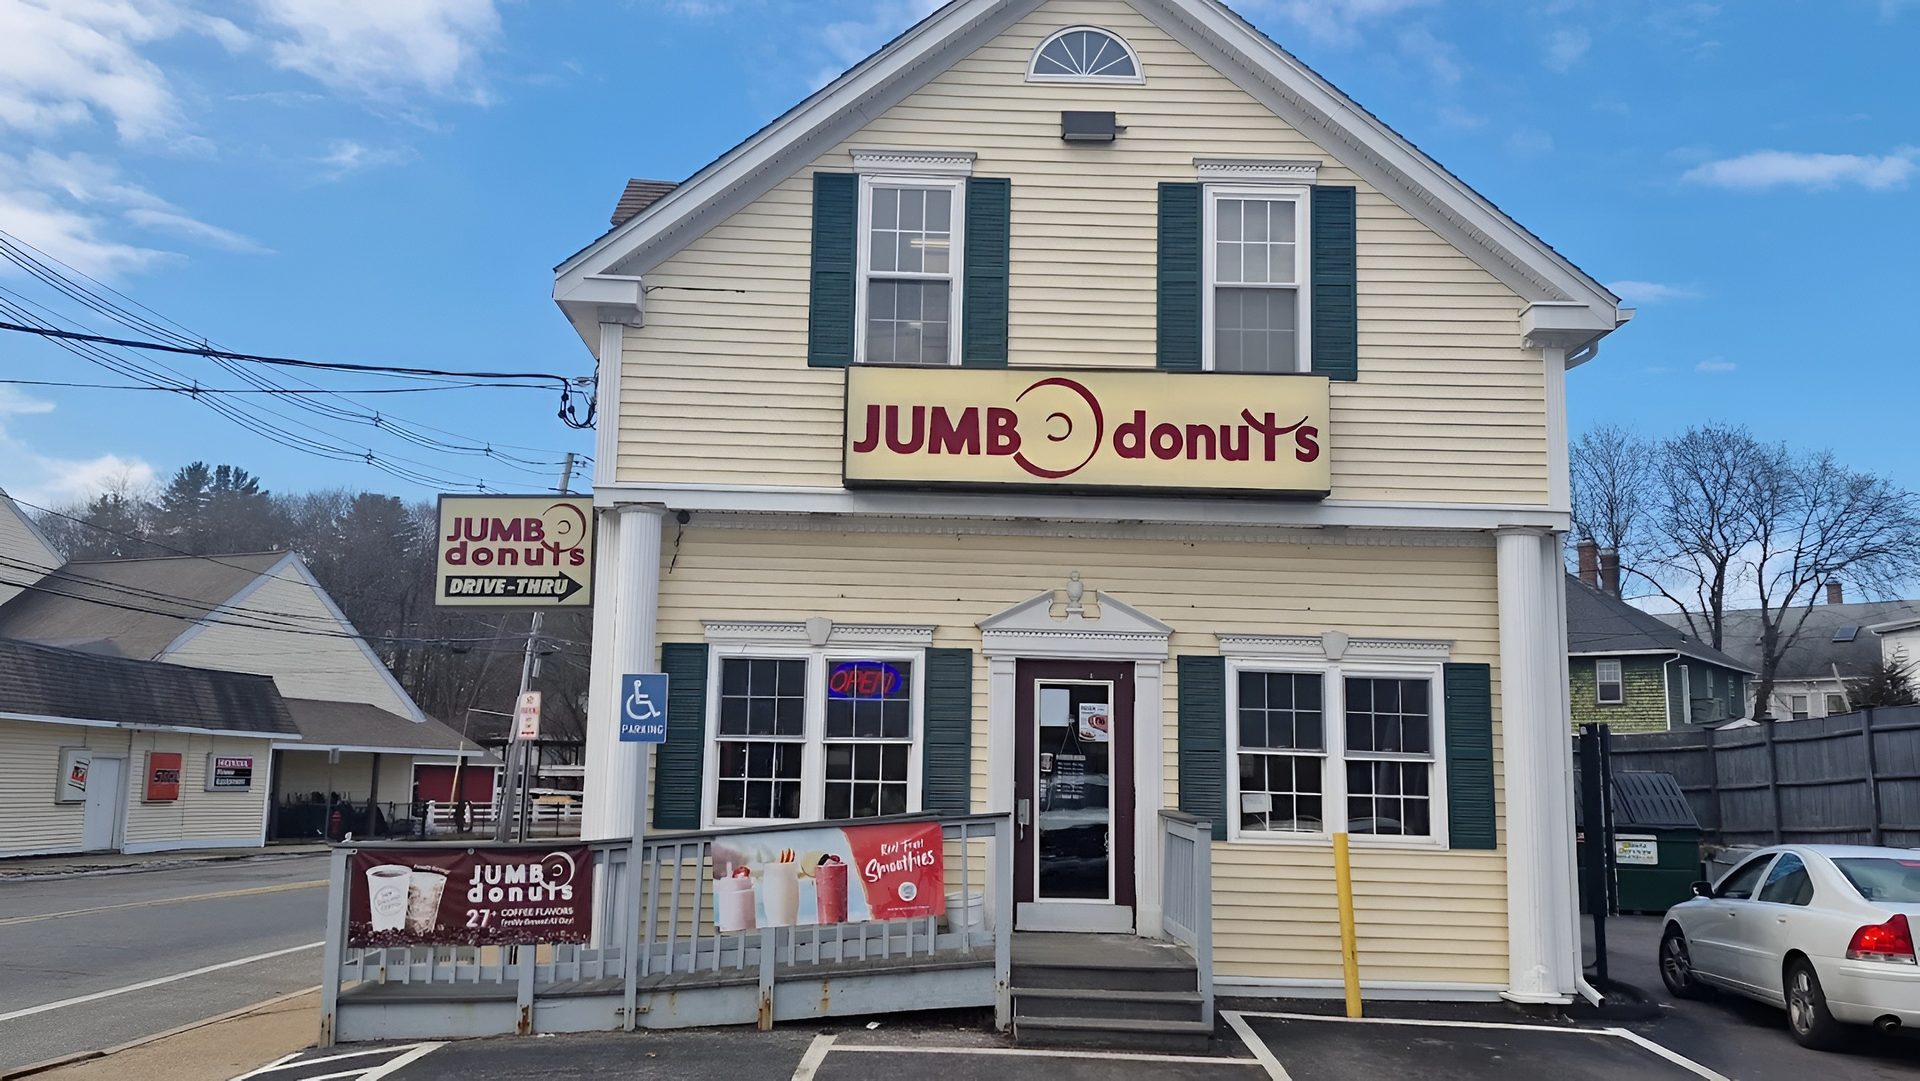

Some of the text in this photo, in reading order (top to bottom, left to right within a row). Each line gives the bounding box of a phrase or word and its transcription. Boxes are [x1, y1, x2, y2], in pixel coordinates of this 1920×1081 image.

[1113, 407, 1320, 463] donuts
[445, 541, 585, 566] donuts
[449, 578, 569, 595] DRIVE-THRU
[830, 670, 895, 695] OPEN
[621, 724, 664, 735] PARKING
[865, 849, 935, 883] Smoothies
[467, 881, 574, 903] donuts
[501, 908, 534, 917] COFFEE
[535, 906, 574, 916] FLAVORS
